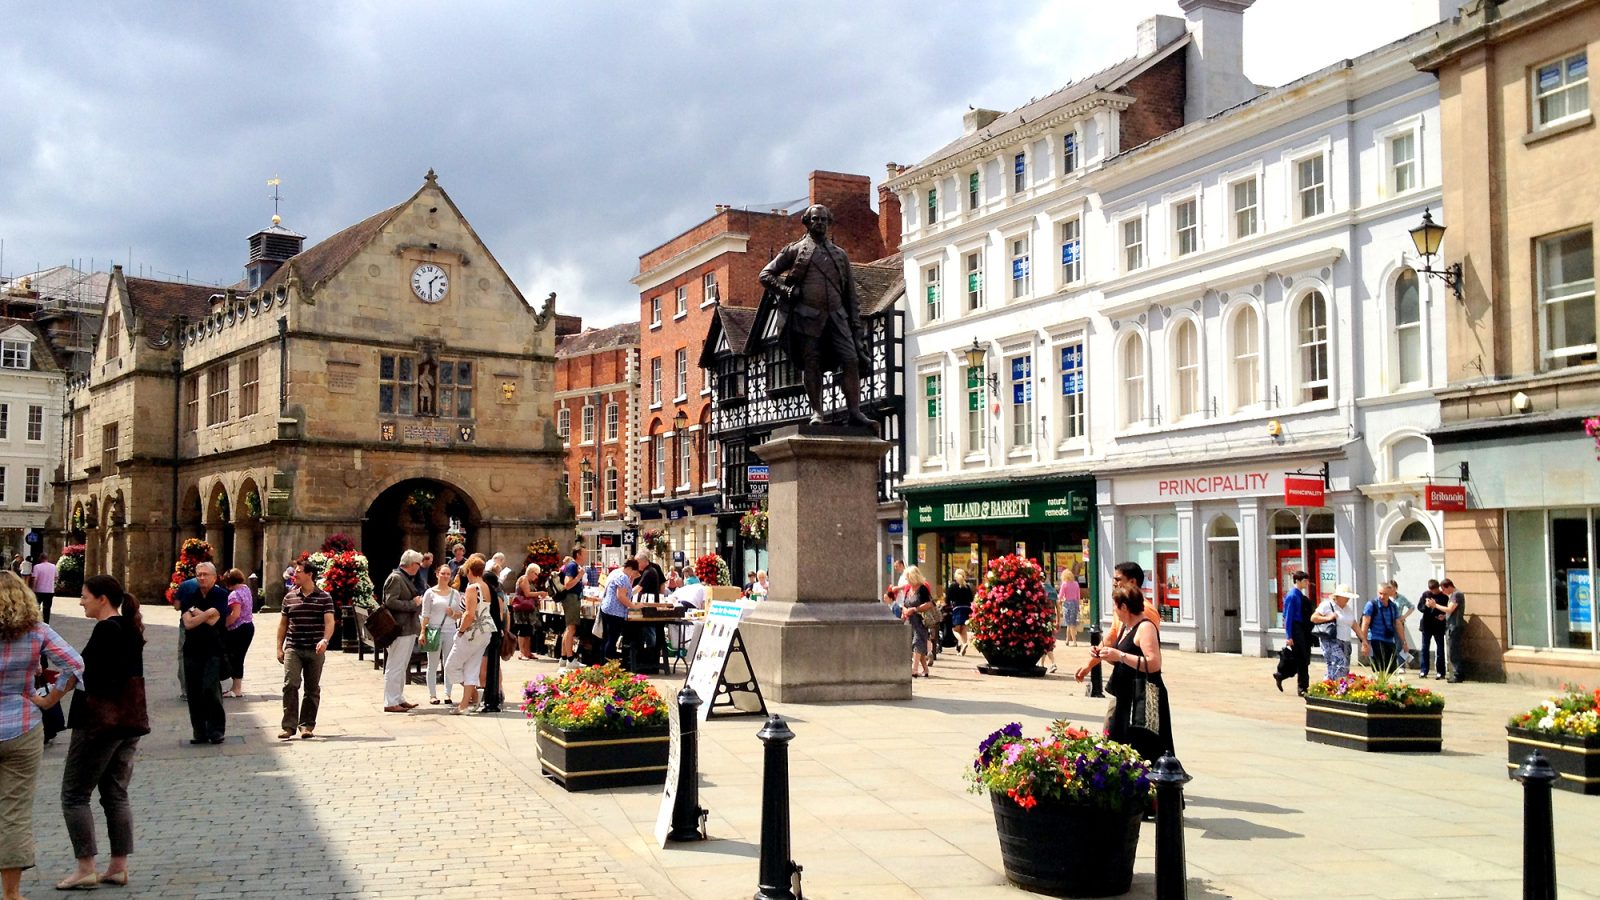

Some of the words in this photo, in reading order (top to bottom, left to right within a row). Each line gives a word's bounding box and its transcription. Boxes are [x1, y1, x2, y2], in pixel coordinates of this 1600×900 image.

[1159, 472, 1269, 496] PRINCIPALITY
[1288, 489, 1322, 497] PRINCIPALITY
[1431, 490, 1464, 501] Britannia
[1047, 496, 1067, 506] natural
[944, 502, 980, 521] HOLLAND
[980, 501, 991, 519] &
[990, 498, 1030, 518] BARRETT
[1045, 507, 1069, 517] remedies
